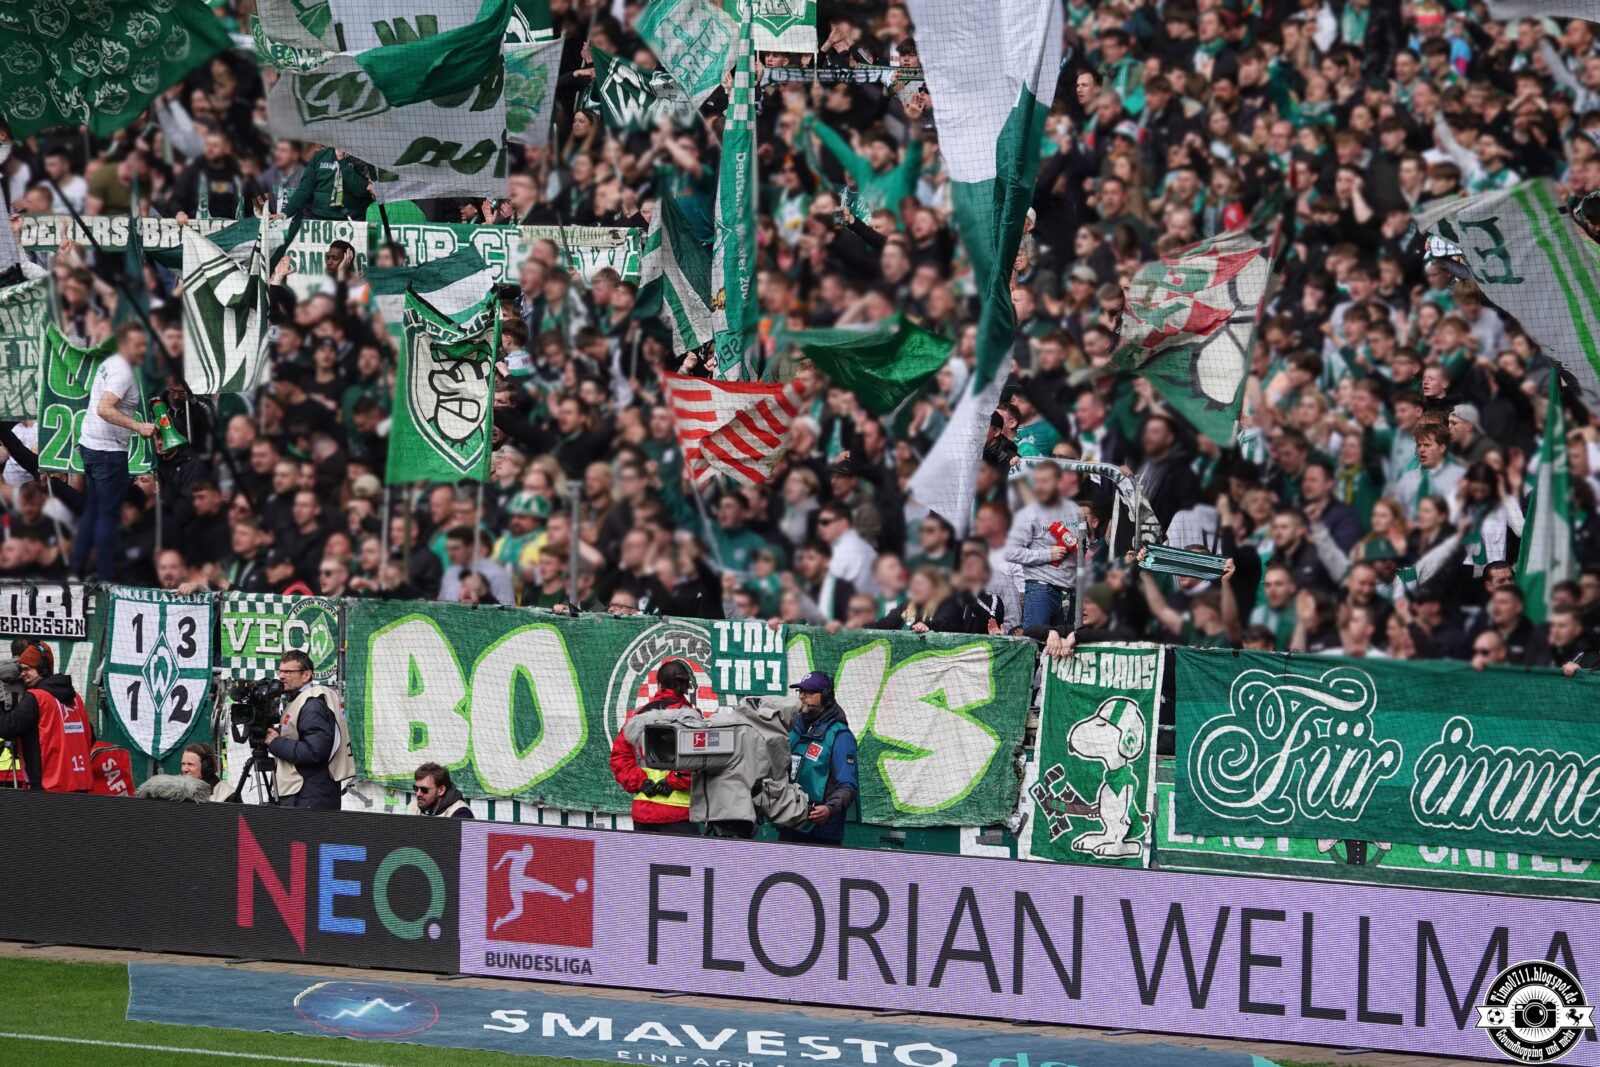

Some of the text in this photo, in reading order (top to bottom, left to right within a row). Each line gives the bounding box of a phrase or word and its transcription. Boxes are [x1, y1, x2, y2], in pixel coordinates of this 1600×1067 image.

[300, 220, 333, 244] PRO
[152, 590, 169, 603] LA
[222, 618, 310, 655] VEC
[714, 659, 783, 691] ביחד
[1099, 652, 1157, 690] RAUS
[1194, 673, 1400, 818] Für
[647, 863, 1083, 1001] FLORIAN
[485, 951, 593, 975] BUNDESLIGA
[483, 1009, 958, 1067] SMAVESTO
